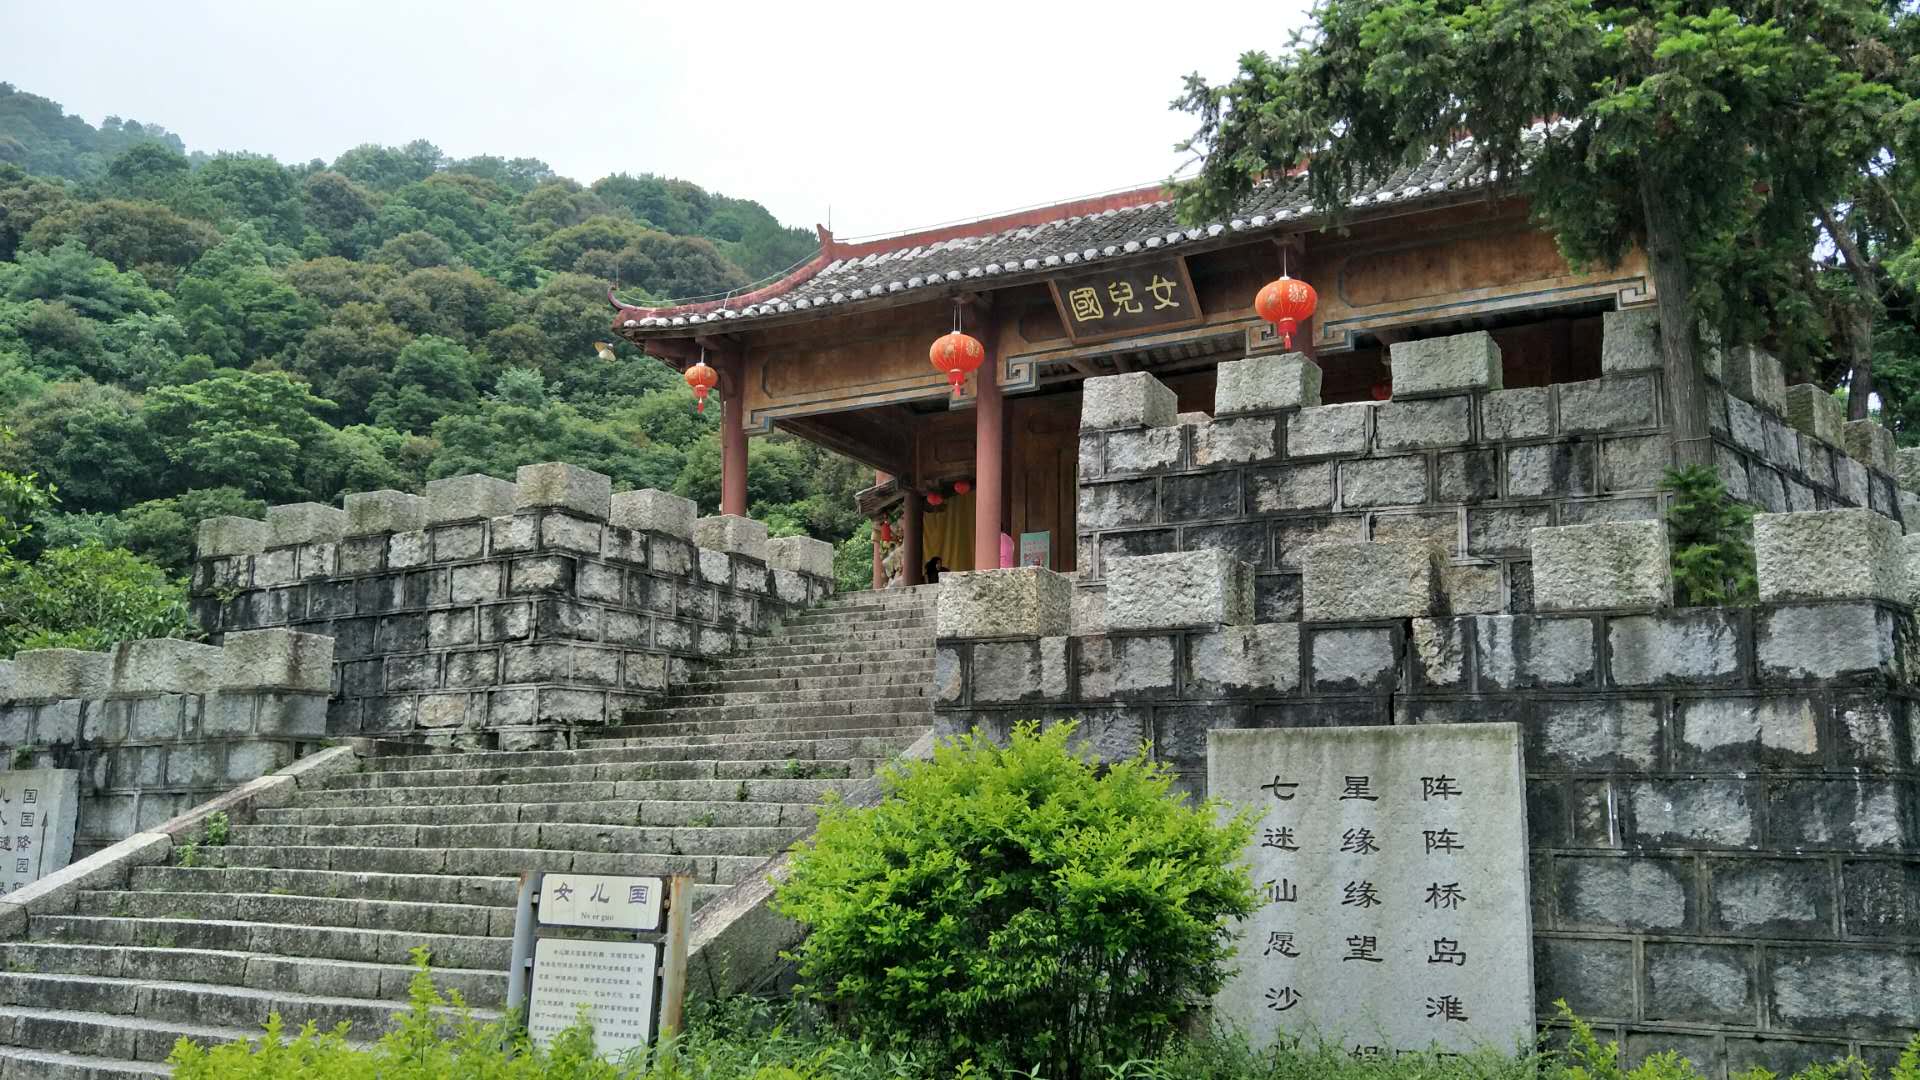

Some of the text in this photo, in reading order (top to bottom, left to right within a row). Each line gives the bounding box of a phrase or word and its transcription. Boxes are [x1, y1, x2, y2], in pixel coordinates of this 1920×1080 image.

[1260, 774, 1463, 802] 七星阵
[553, 881, 649, 905] 女儿国
[1266, 878, 1467, 911] 仙缘桥
[1263, 931, 1467, 967] 愿望岛
